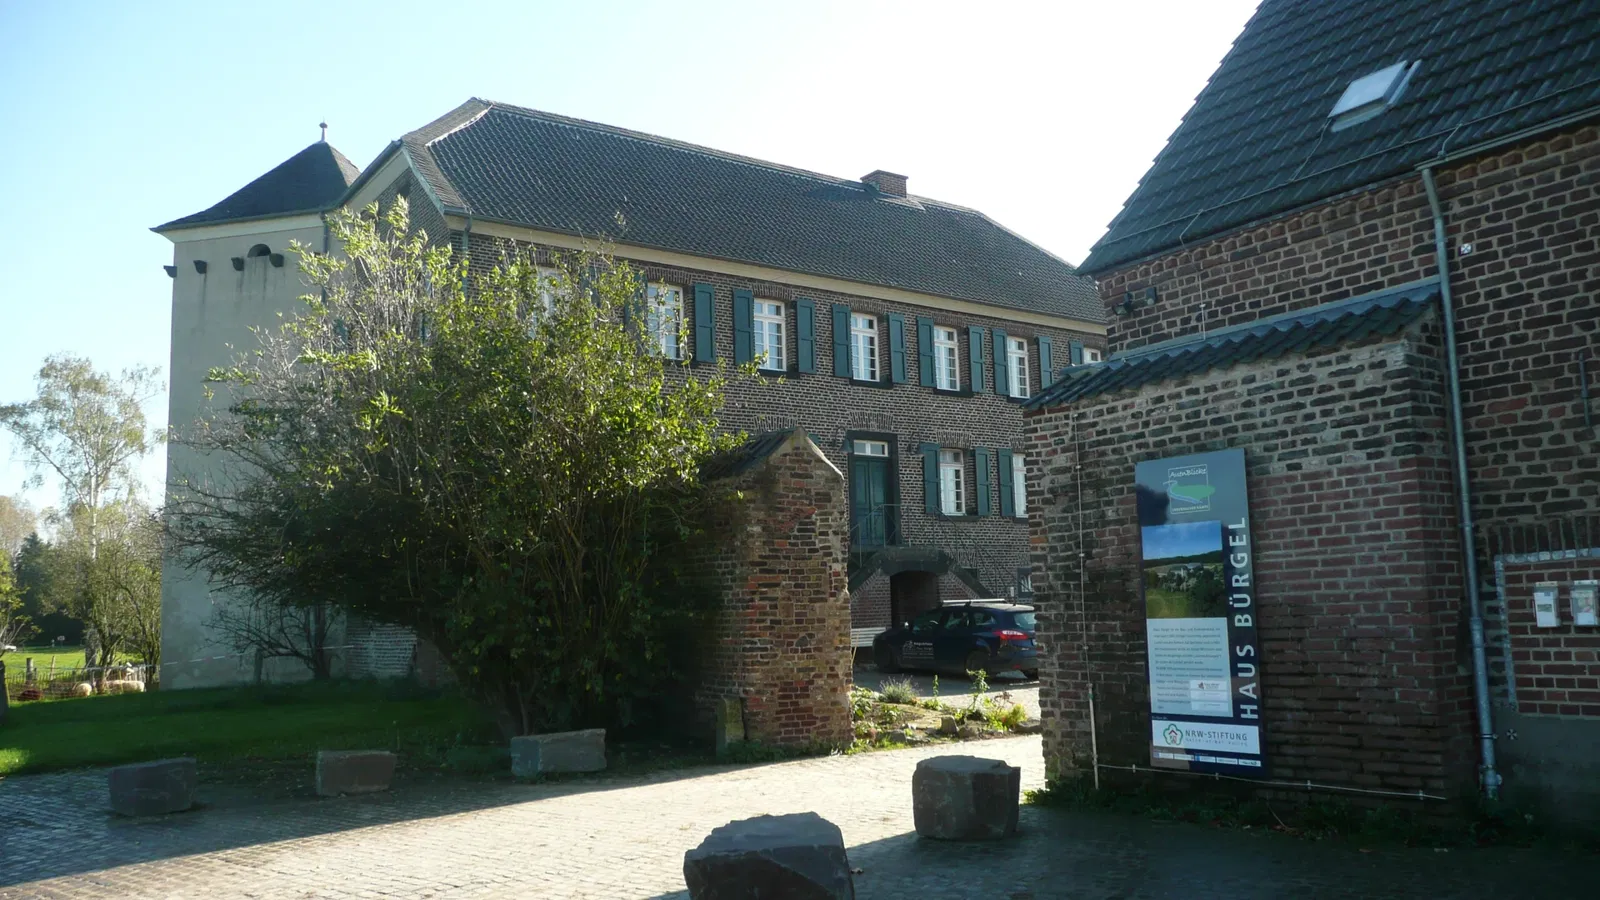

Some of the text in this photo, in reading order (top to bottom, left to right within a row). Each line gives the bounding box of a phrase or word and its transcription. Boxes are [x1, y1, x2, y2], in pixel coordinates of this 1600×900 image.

[1228, 517, 1259, 719] HAUS BÜRGEL
[1185, 729, 1248, 741] NRW-STIFTUNG
